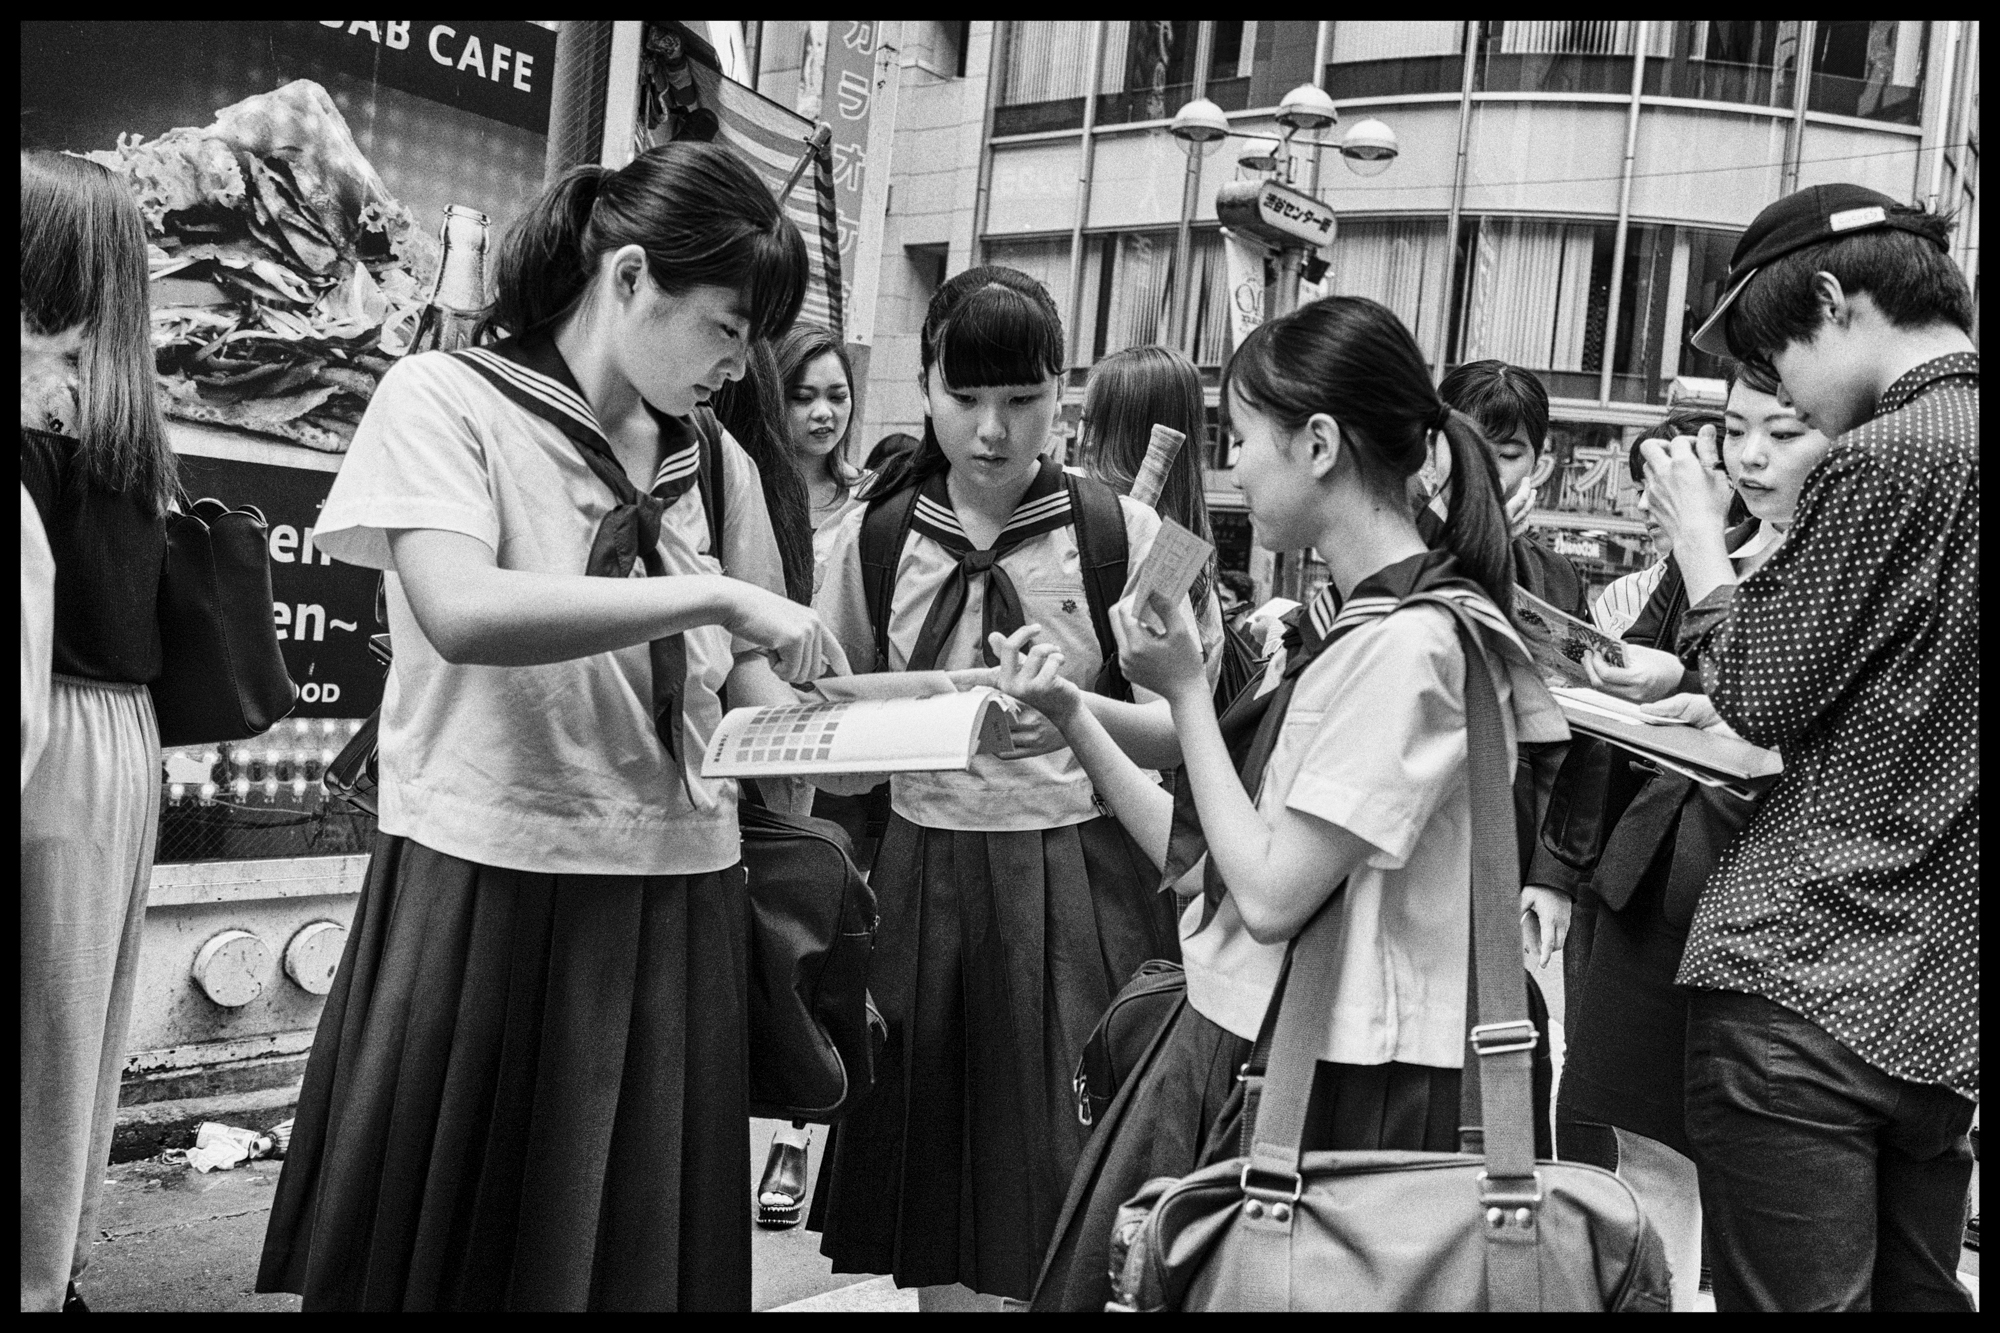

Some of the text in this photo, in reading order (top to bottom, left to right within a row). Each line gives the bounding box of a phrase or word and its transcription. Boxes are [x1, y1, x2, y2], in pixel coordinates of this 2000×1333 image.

[319, 20, 534, 93] AB CAFE
[295, 682, 341, 704] OD
